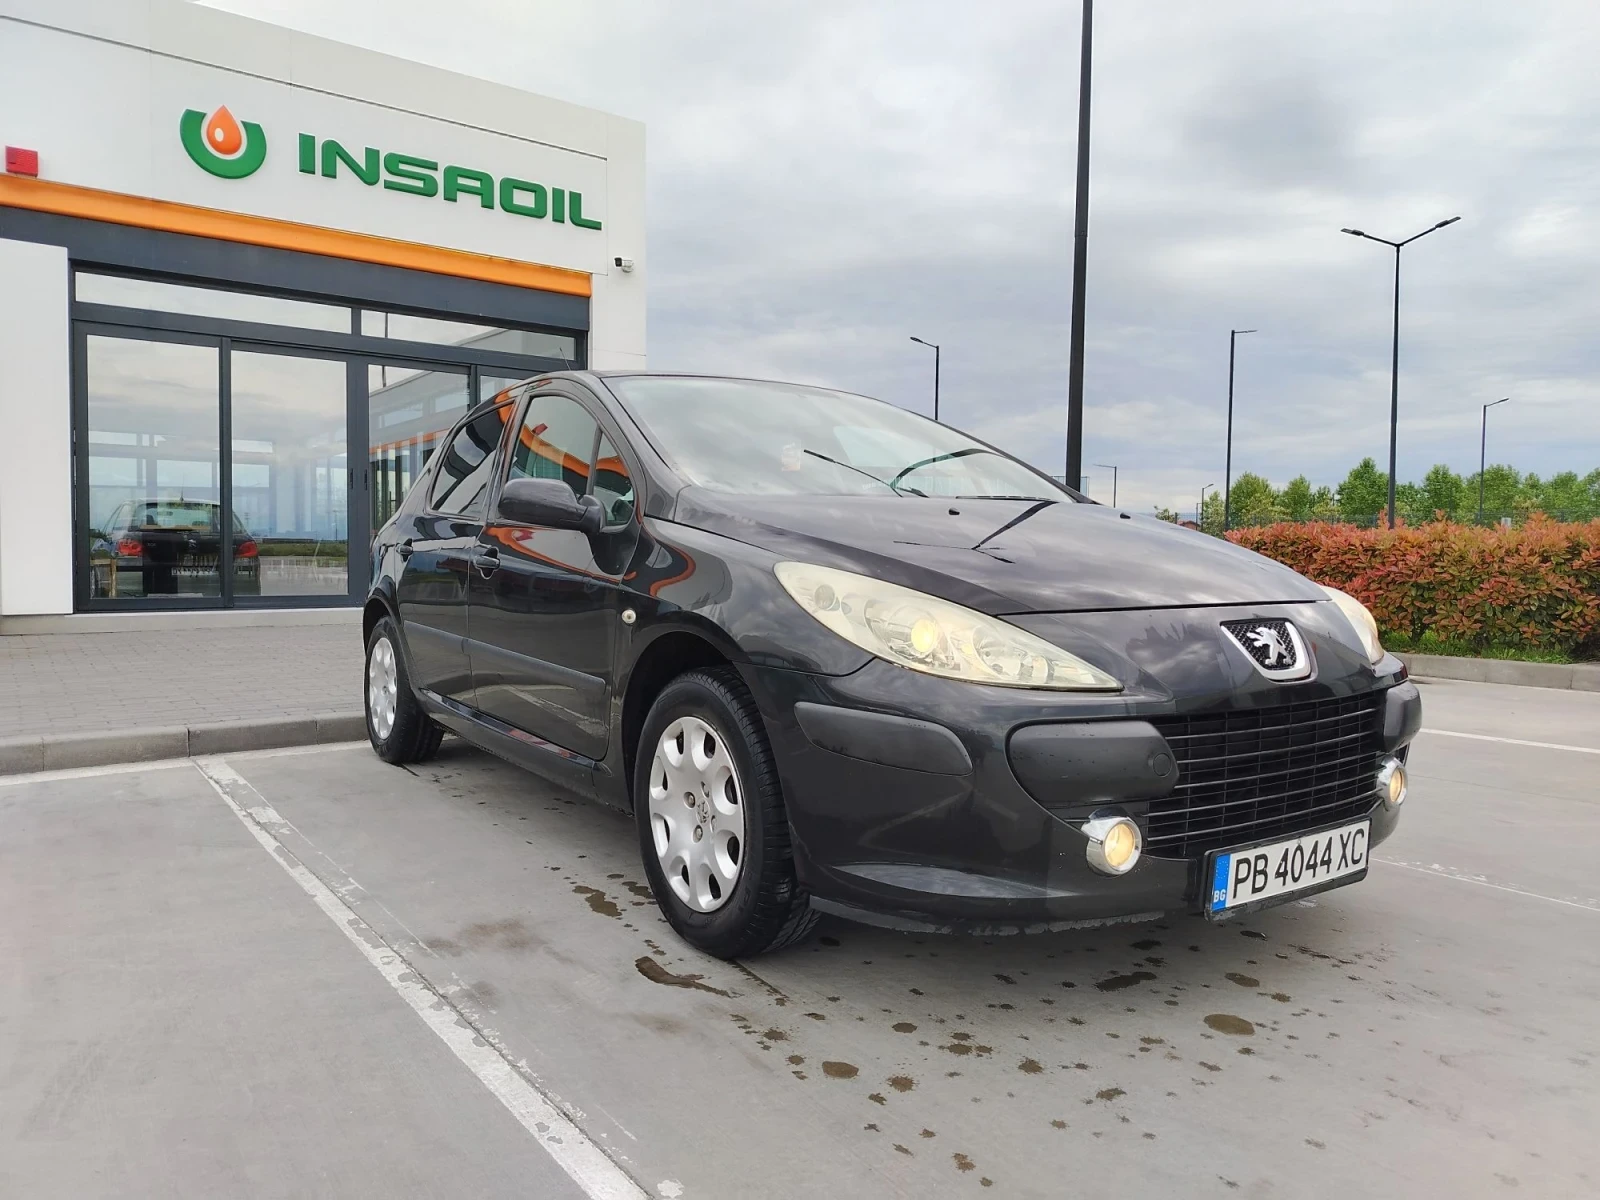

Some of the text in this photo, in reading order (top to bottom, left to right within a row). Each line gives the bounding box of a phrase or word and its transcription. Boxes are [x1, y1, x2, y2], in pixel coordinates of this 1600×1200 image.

[299, 132, 602, 231] INSAOIL
[1213, 889, 1227, 903] BG
[1233, 828, 1365, 899] PB 4044 XC
